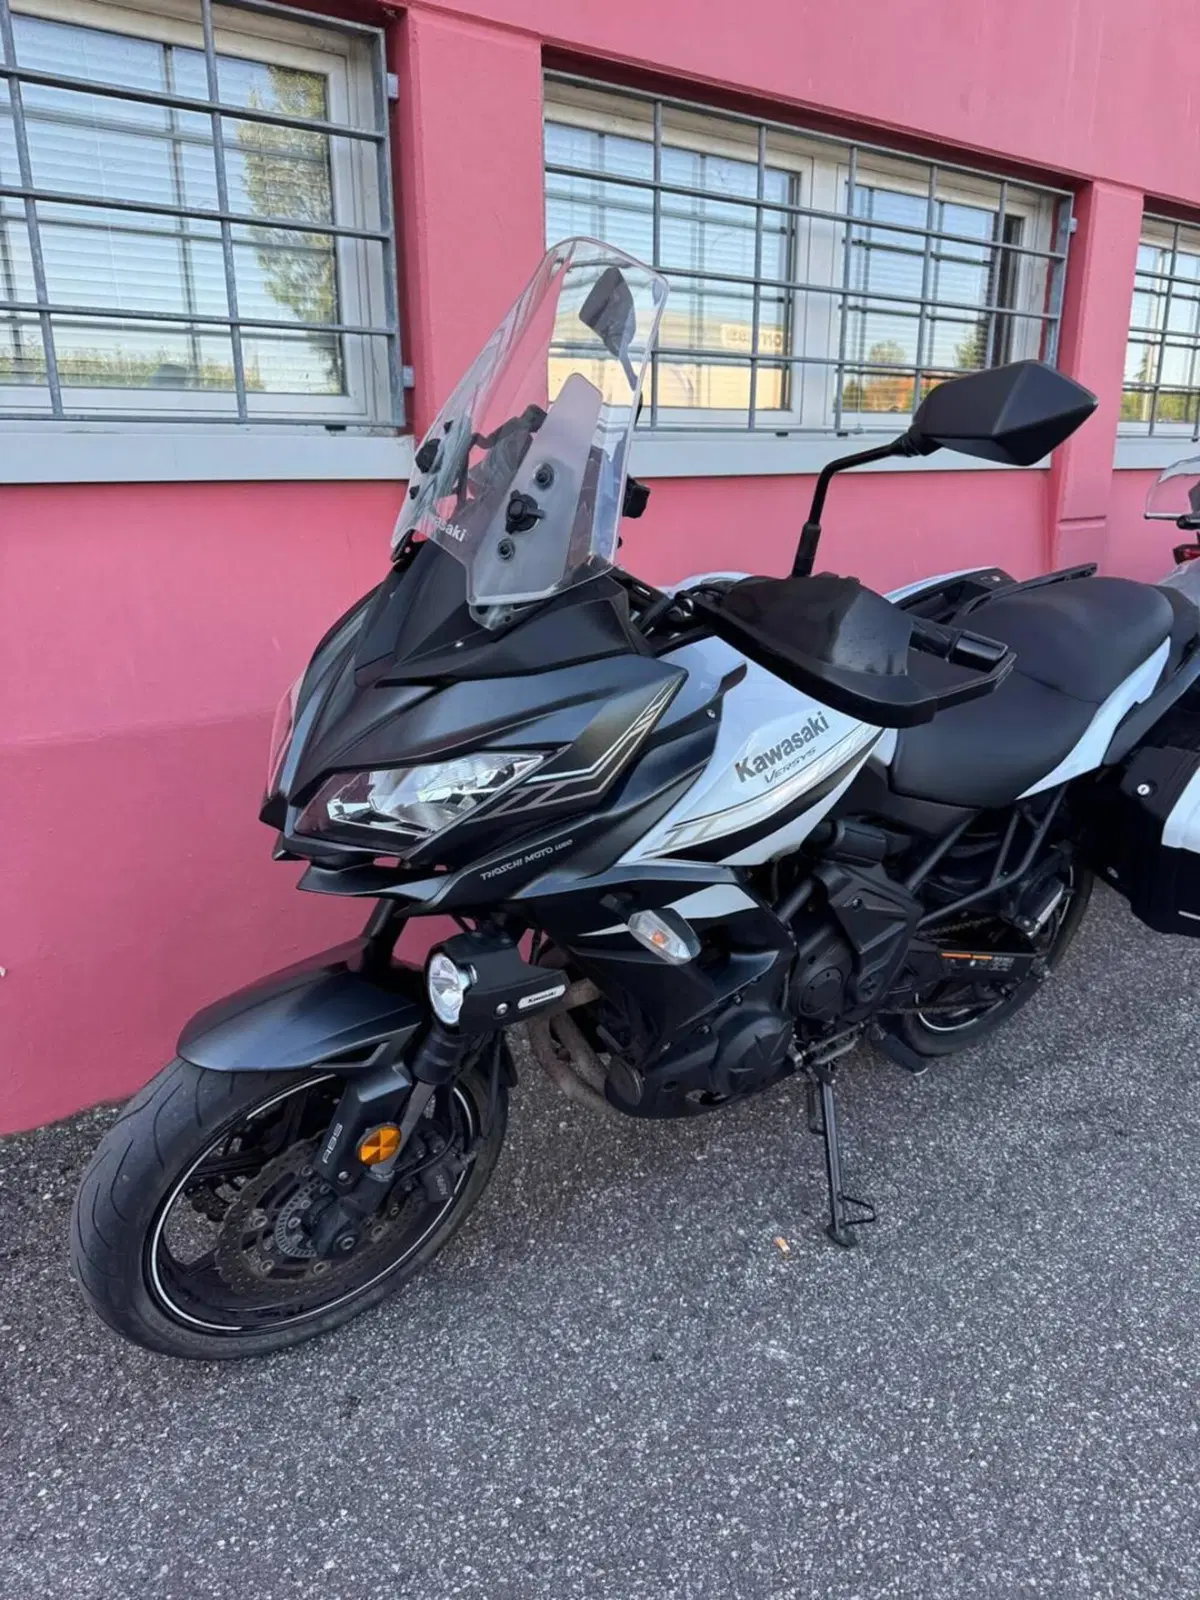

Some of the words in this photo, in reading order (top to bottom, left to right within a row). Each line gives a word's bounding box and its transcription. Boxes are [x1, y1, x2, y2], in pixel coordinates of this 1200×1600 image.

[734, 710, 830, 783] Kawasaki
[524, 845, 554, 864] MOTO
[321, 1122, 344, 1165] ABS
